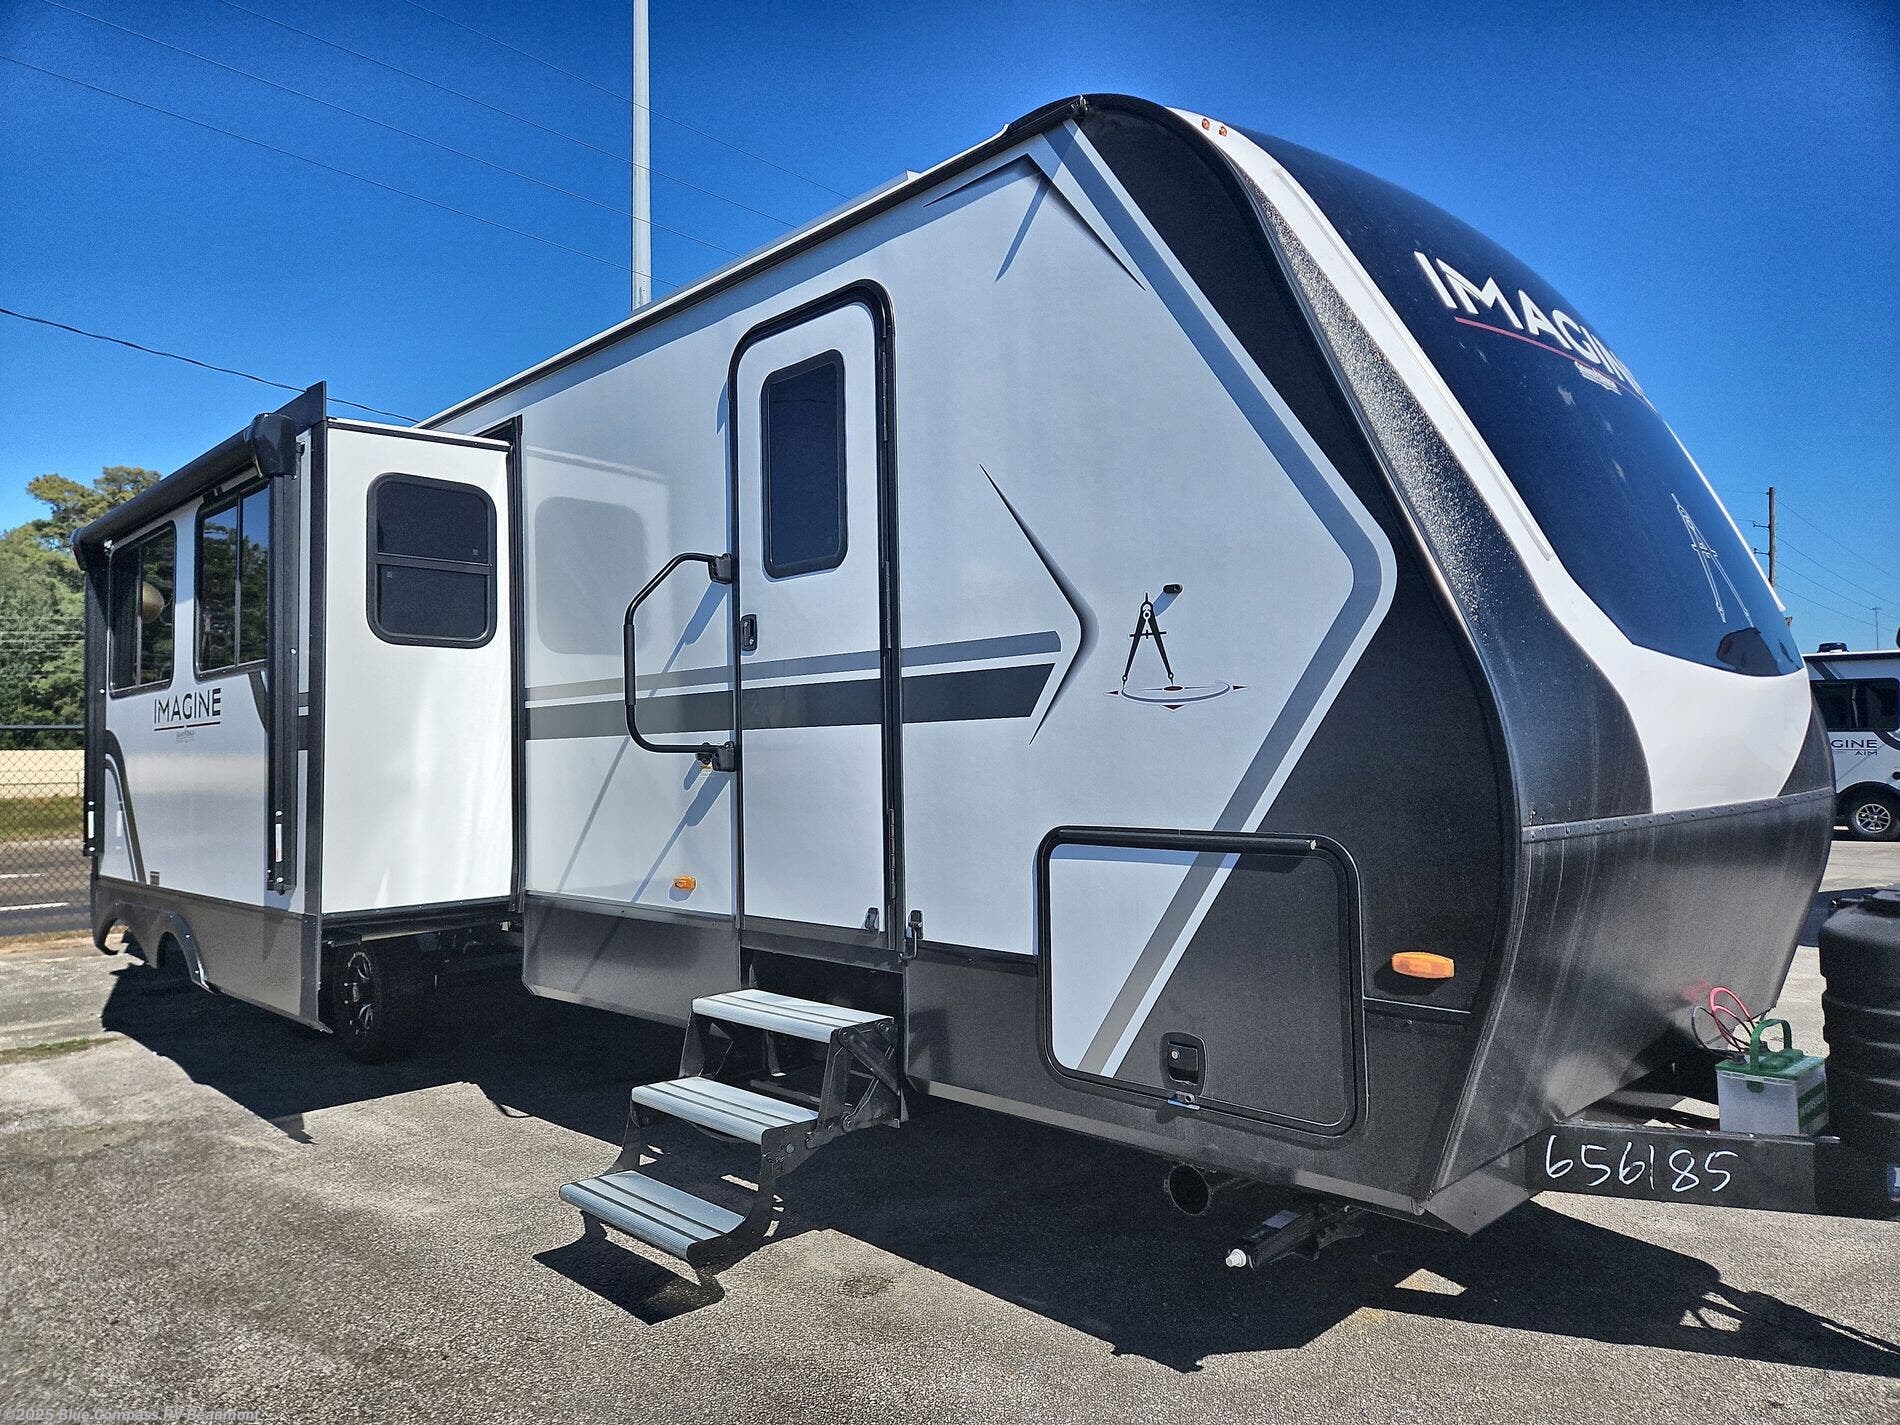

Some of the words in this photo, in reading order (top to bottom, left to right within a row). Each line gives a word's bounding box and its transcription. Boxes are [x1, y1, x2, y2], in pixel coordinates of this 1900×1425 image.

[1411, 250, 1657, 414] IMAGIN
[153, 687, 222, 724] IMAGINE
[1545, 1135, 1739, 1192] 656185
